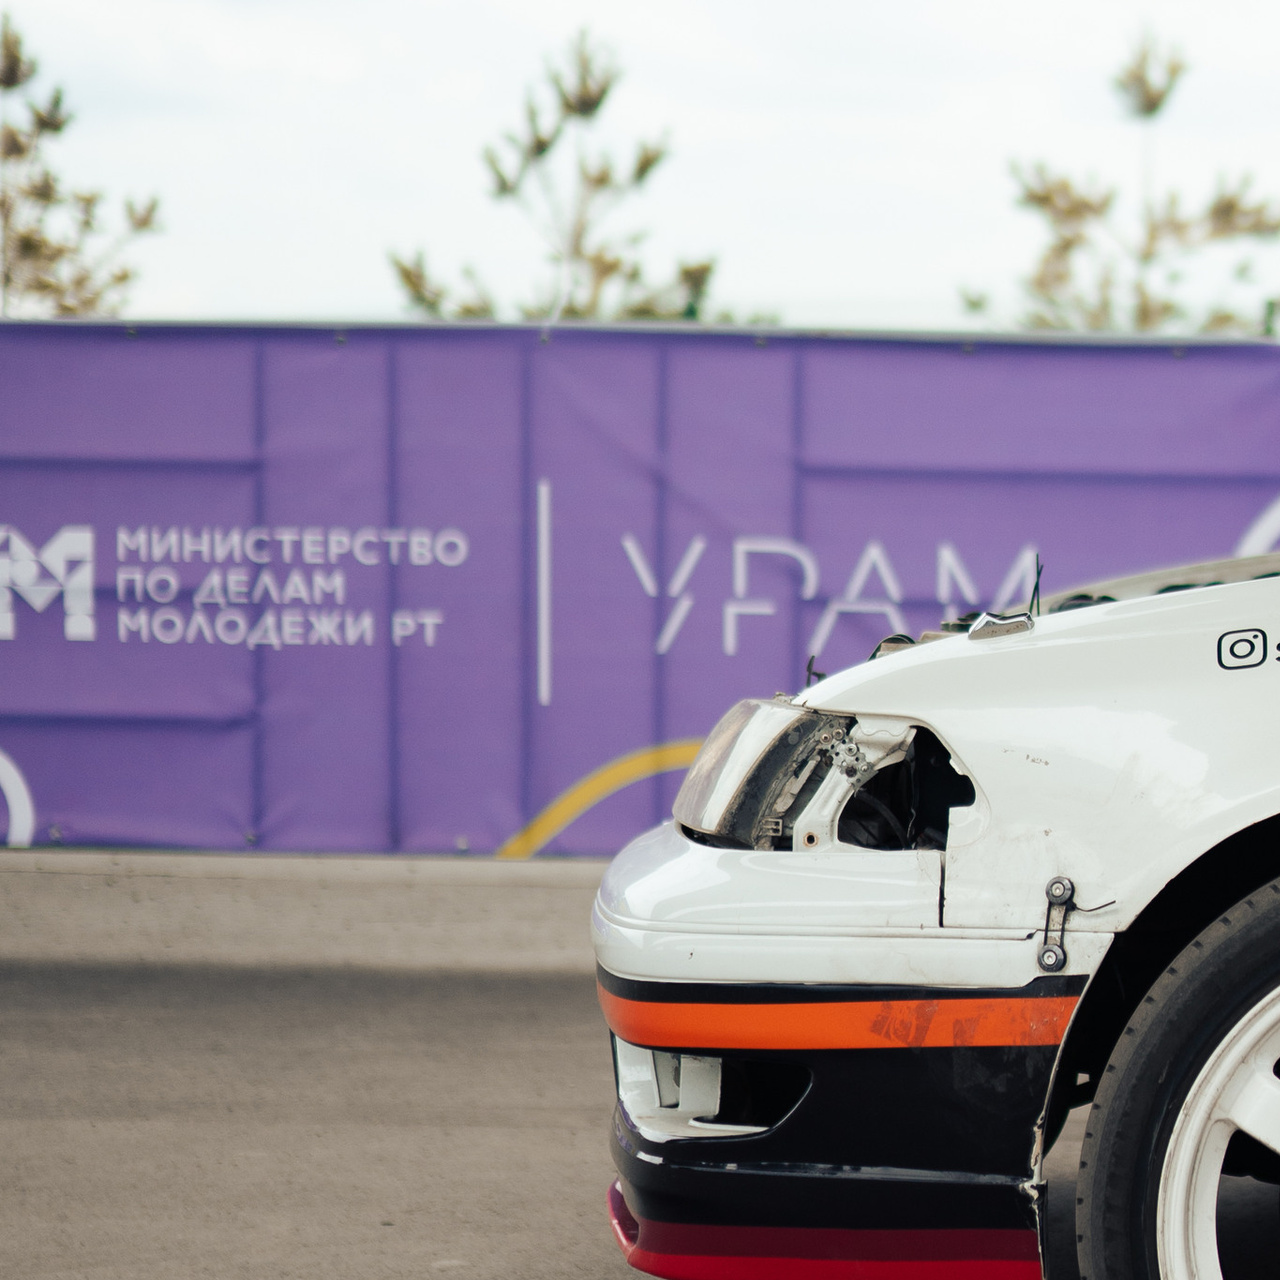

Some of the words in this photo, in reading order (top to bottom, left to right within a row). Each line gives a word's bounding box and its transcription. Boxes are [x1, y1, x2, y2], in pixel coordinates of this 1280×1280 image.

[116, 526, 469, 567] МИНИСТЕРСТВО
[116, 567, 179, 604] ПО
[194, 568, 346, 608] ДЕЛАМ
[117, 607, 375, 651] МОЛОДЕЖИ
[391, 609, 444, 647] РТ
